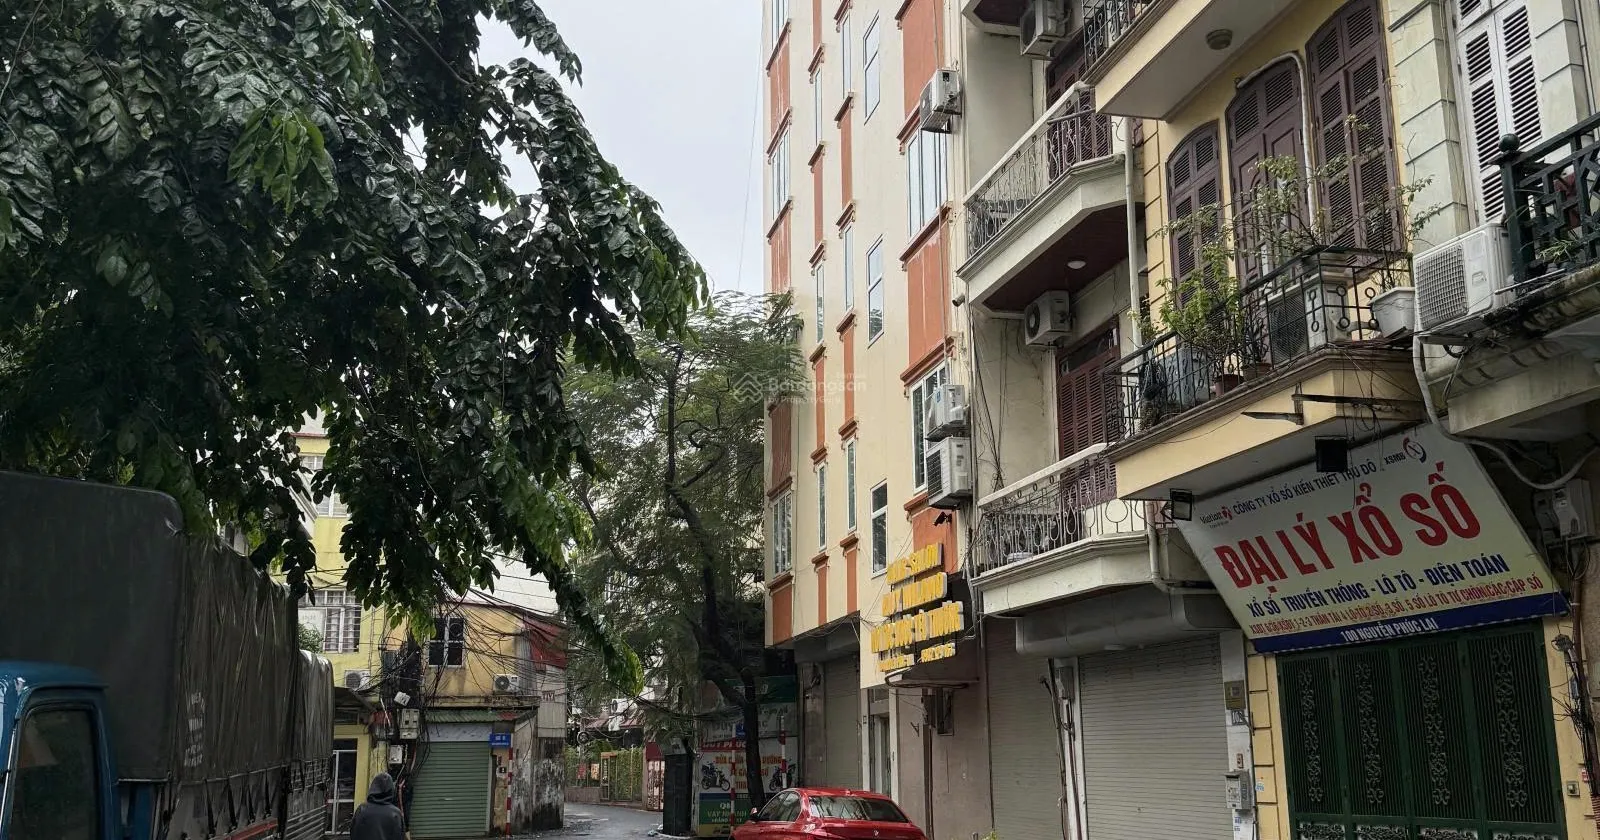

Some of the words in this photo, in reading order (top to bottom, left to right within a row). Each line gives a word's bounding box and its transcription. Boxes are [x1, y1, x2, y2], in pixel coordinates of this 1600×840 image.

[1384, 452, 1406, 465] XSMB
[1232, 500, 1257, 515] CÔNG
[1254, 496, 1273, 508] TY
[1266, 486, 1281, 505] XỔ
[1280, 482, 1294, 501] SỐ
[1294, 477, 1315, 497] KIẾN
[1360, 458, 1377, 476] ĐÔ
[1213, 535, 1288, 594] ĐẠI
[1275, 512, 1335, 576] LÝ
[1327, 482, 1403, 564] XỔ
[1400, 461, 1481, 547] SỐ
[1246, 596, 1266, 618] XỔ
[1263, 594, 1282, 614] SỐ
[1280, 587, 1329, 612] TRUYỀN
[1324, 580, 1371, 605] THỐNG
[1375, 573, 1397, 595] LÔ
[1393, 569, 1417, 591] TÔ
[1424, 562, 1466, 587] ĐIỆN
[1461, 553, 1510, 578] TOÁN
[1412, 593, 1426, 609] SỐ
[1526, 571, 1544, 590] SỐ
[1340, 629, 1359, 642] 100
[1357, 621, 1397, 640] NGUYỄN
[1393, 619, 1421, 635] PHÚC
[1420, 617, 1439, 631] LAI
